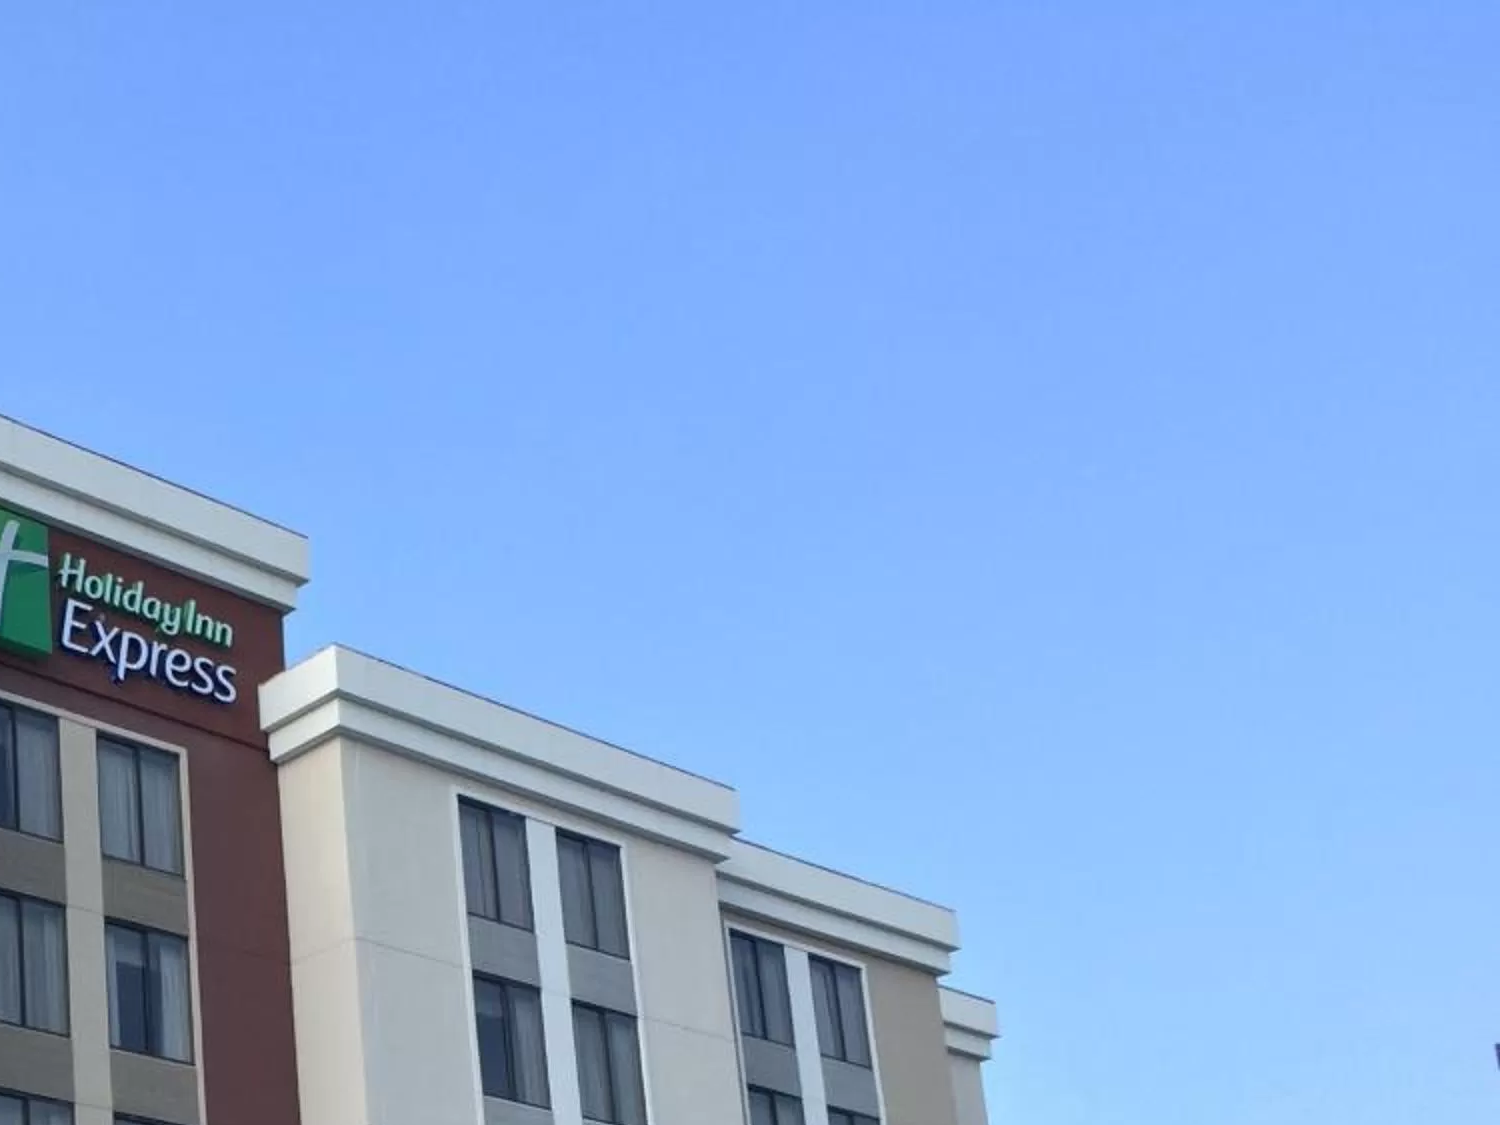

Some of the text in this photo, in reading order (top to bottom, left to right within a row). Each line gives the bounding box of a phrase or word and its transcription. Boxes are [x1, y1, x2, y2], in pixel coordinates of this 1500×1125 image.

[58, 552, 233, 647] Holiday Inn
[60, 598, 238, 704] Express
